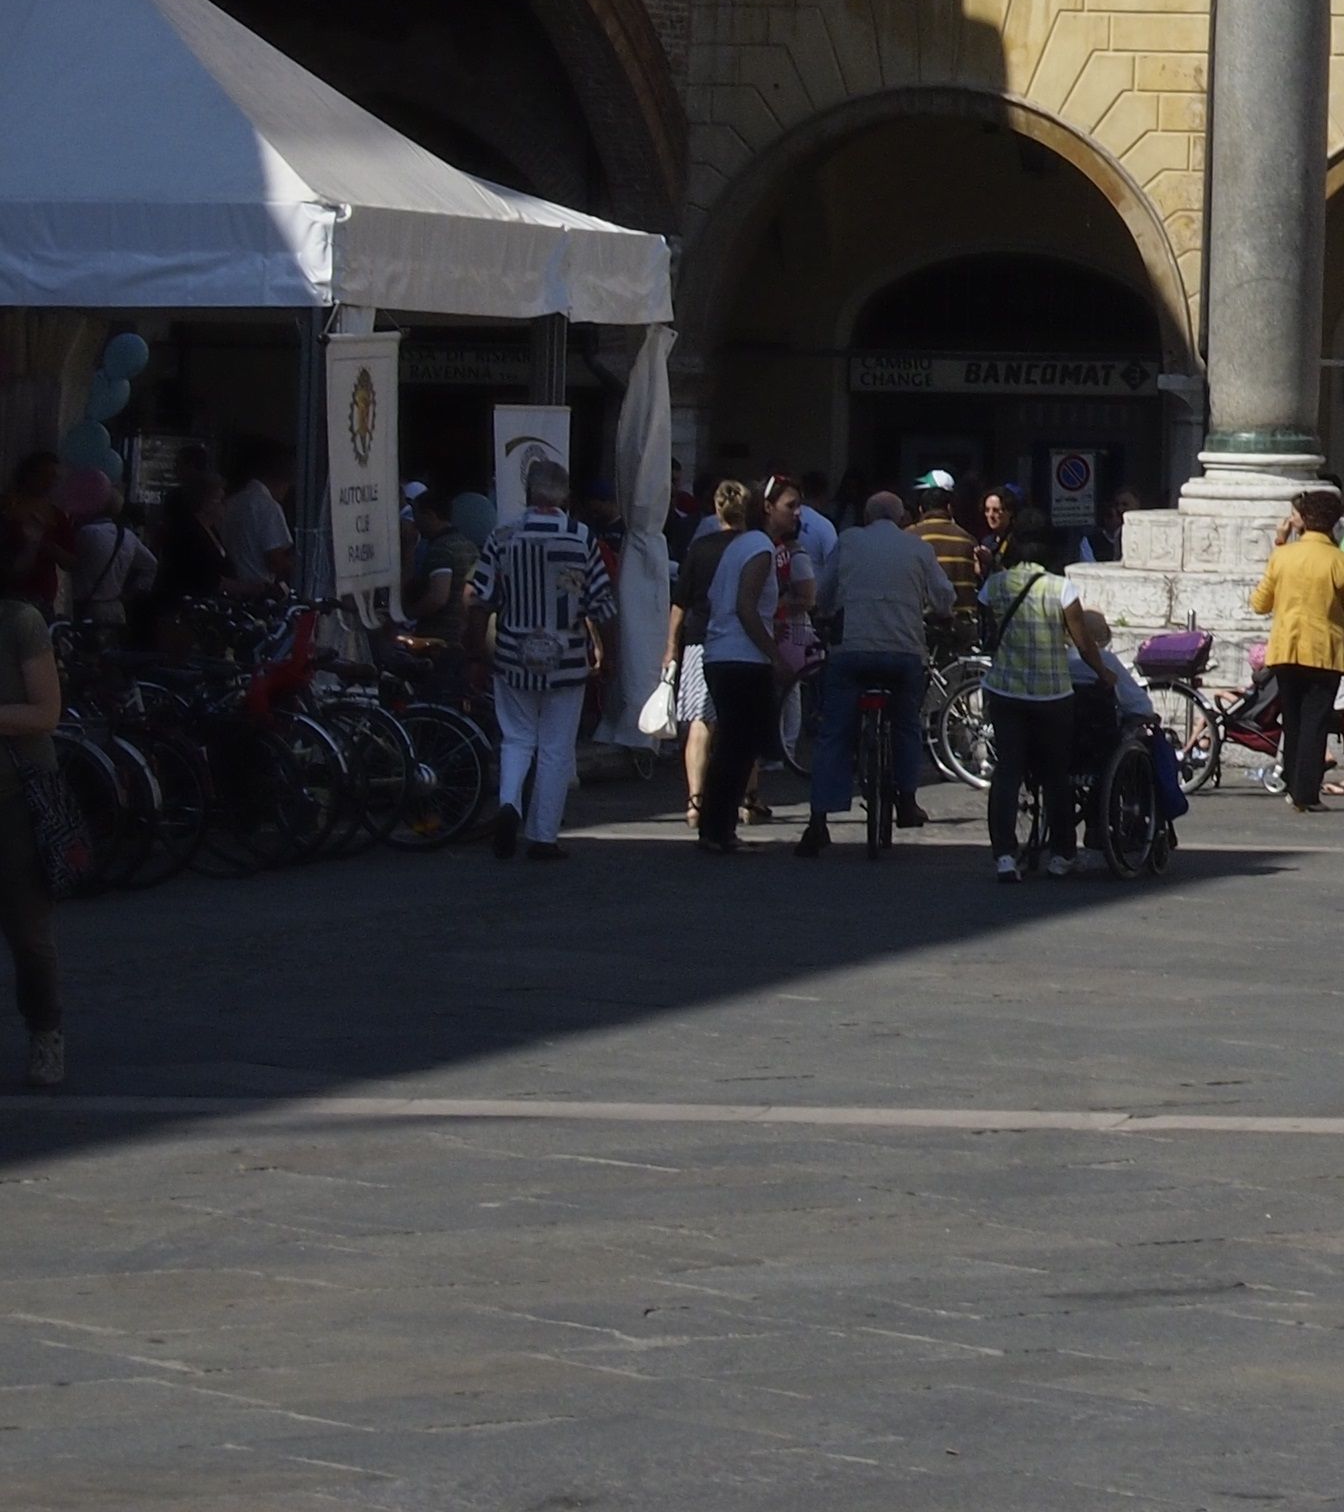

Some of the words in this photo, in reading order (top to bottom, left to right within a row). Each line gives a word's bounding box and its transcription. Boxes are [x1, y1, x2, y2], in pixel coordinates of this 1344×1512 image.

[863, 357, 932, 372] CAMBIO
[860, 372, 934, 387] CHANGE
[964, 361, 1116, 385] BANCOMAT
